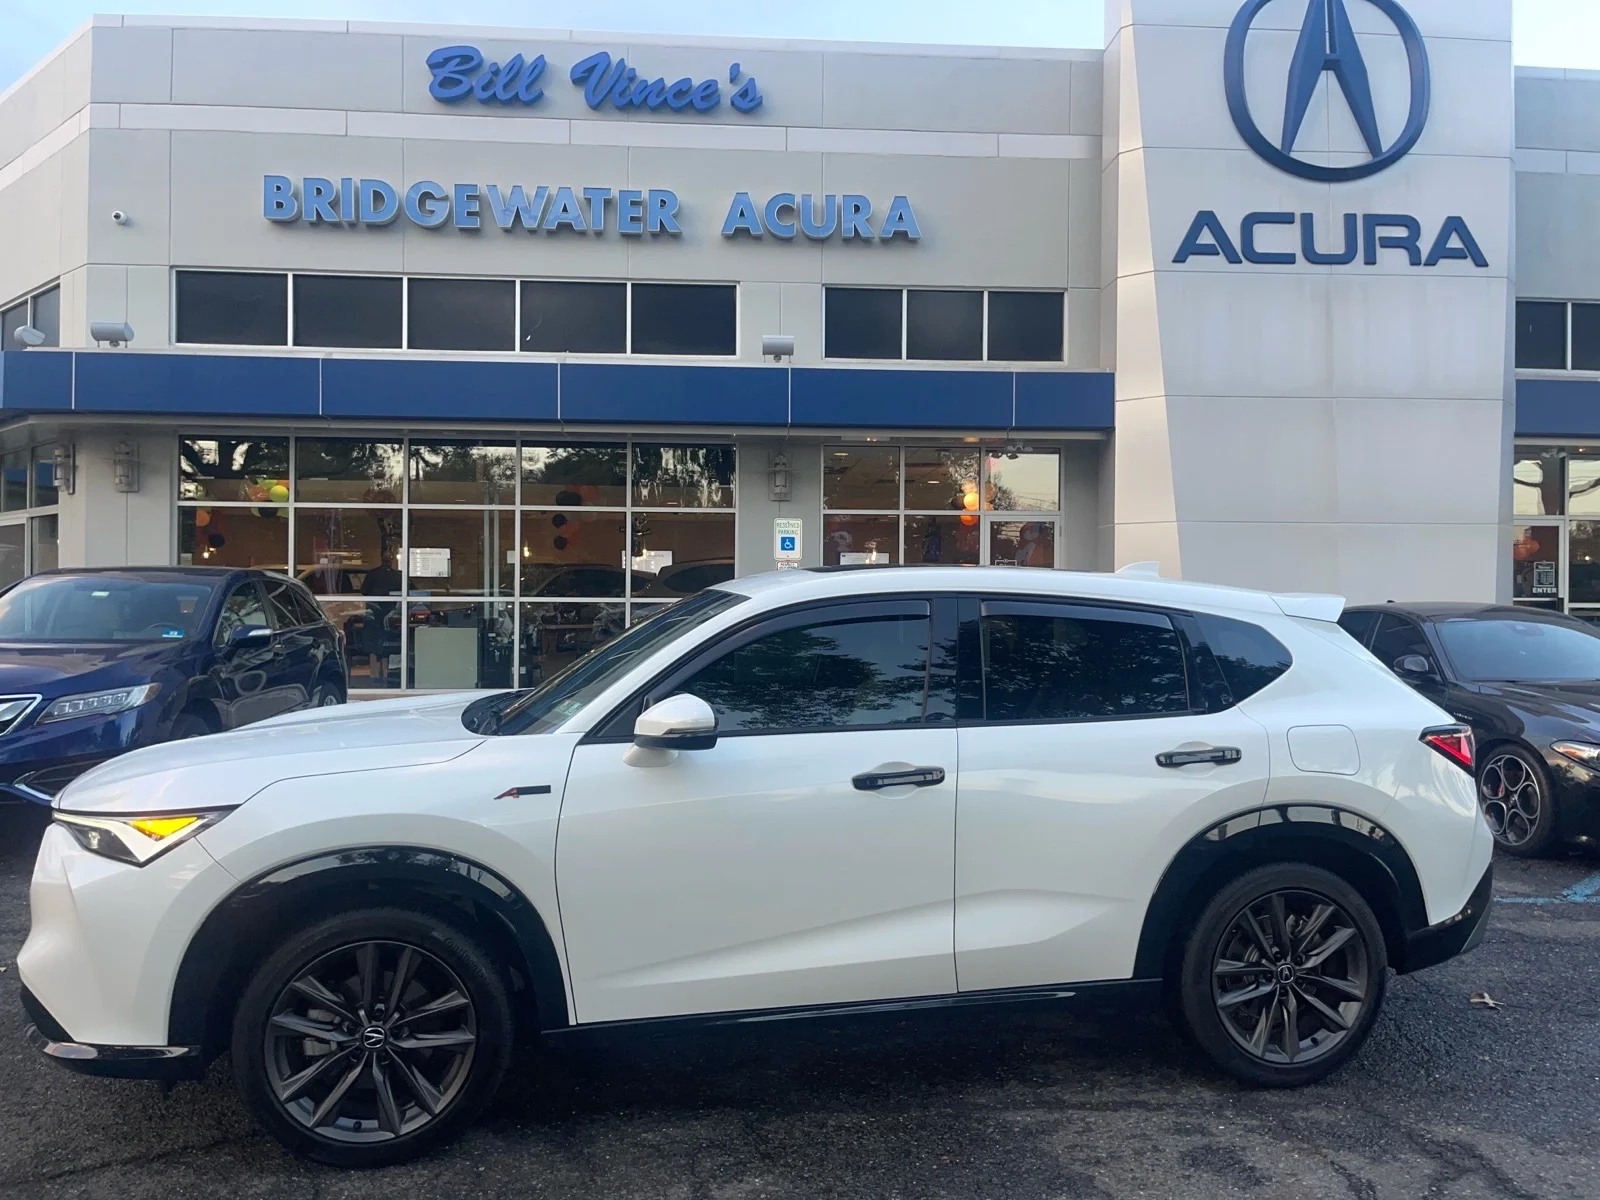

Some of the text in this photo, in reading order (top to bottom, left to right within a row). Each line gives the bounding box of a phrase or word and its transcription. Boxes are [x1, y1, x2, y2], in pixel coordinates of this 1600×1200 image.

[426, 45, 763, 113] Bill Vince's
[263, 174, 922, 240] BRIDGEWATER ACURA
[1171, 210, 1489, 267] ACURA
